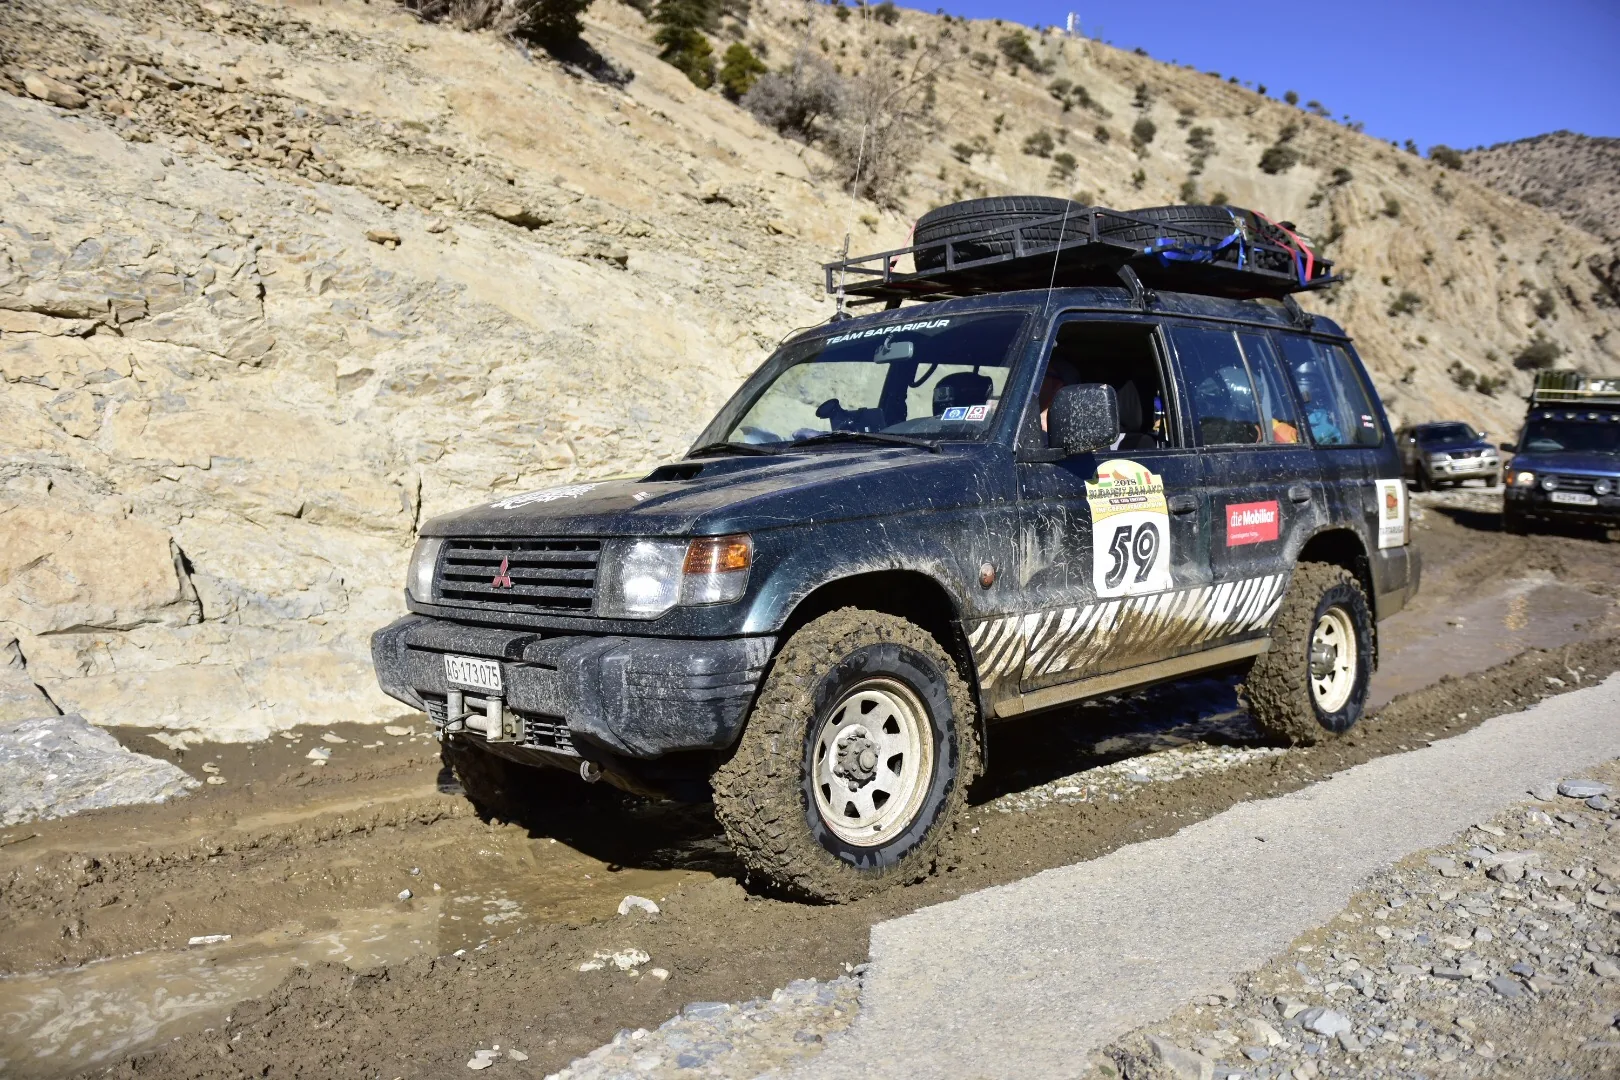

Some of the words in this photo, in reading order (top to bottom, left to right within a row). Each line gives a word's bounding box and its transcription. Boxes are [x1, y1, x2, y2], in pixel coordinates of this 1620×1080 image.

[826, 332, 863, 345] TEAM
[863, 319, 950, 338] SAFARIPUR
[1114, 479, 1137, 487] 2018
[1230, 511, 1243, 527] die
[1243, 509, 1275, 526] Mobiliar
[1104, 521, 1160, 590] 59
